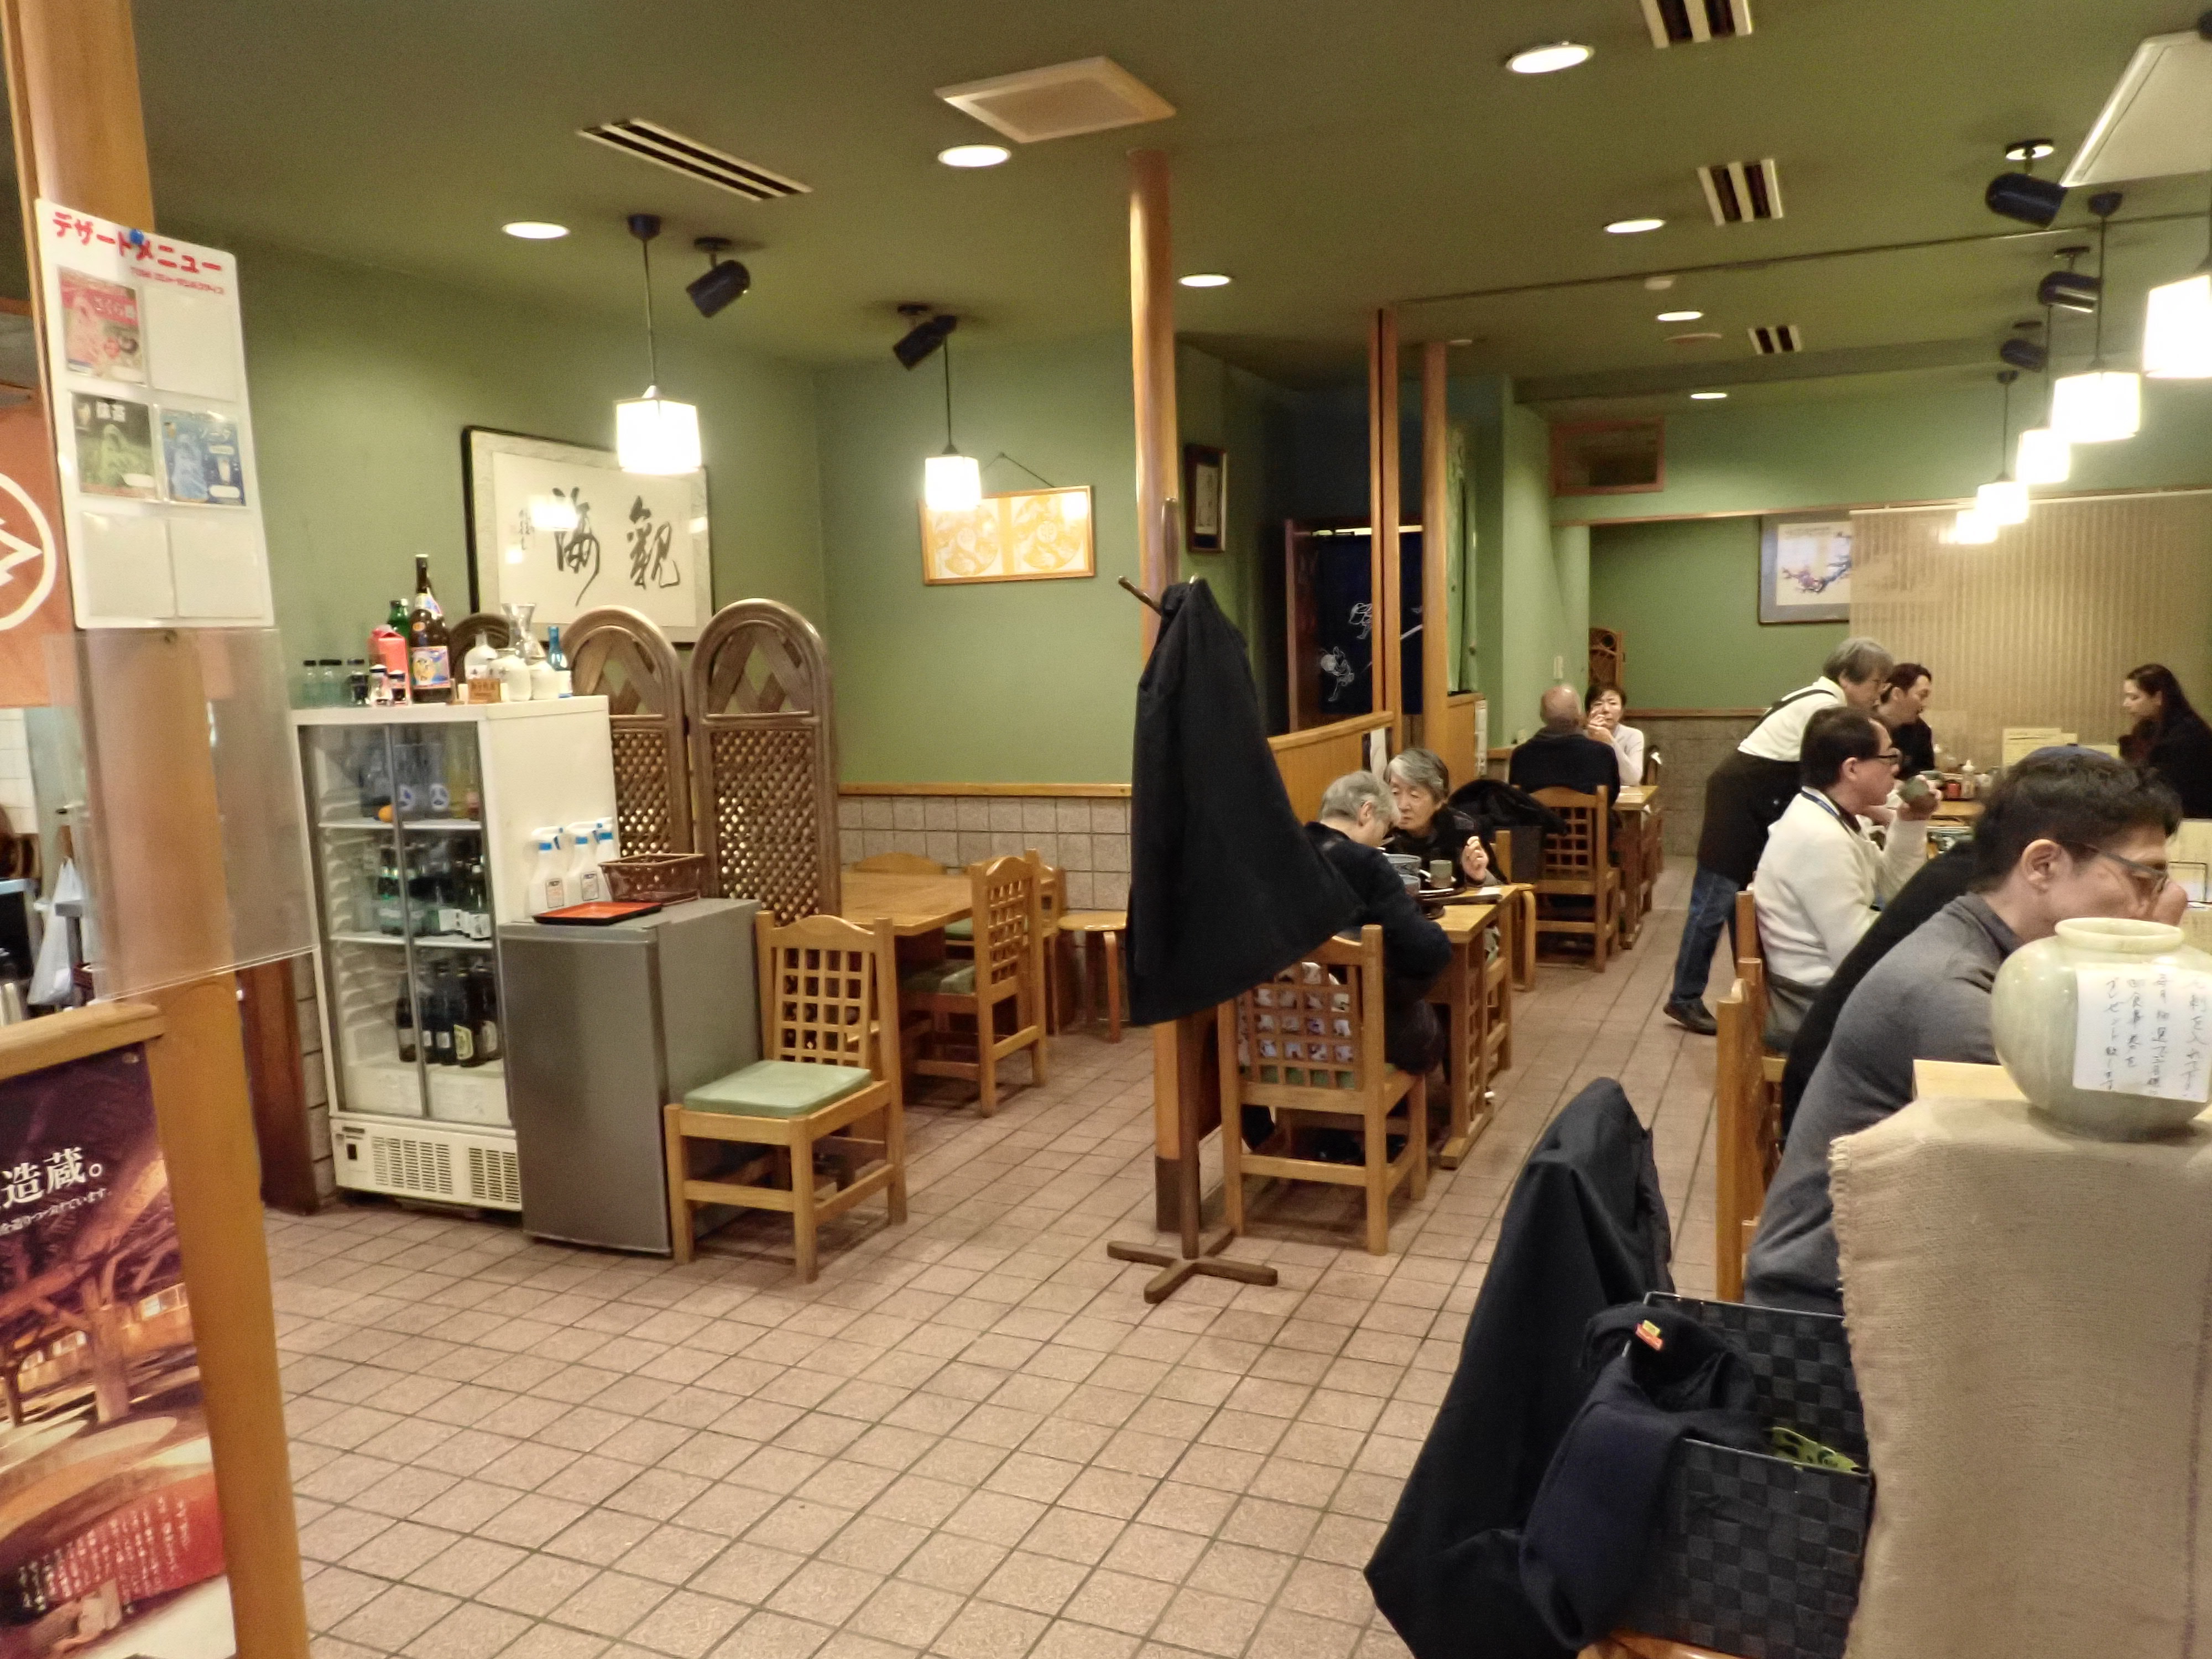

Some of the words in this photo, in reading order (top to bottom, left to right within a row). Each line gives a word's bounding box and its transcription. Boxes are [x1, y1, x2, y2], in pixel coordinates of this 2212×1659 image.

[53, 211, 222, 274] デザートメニュー
